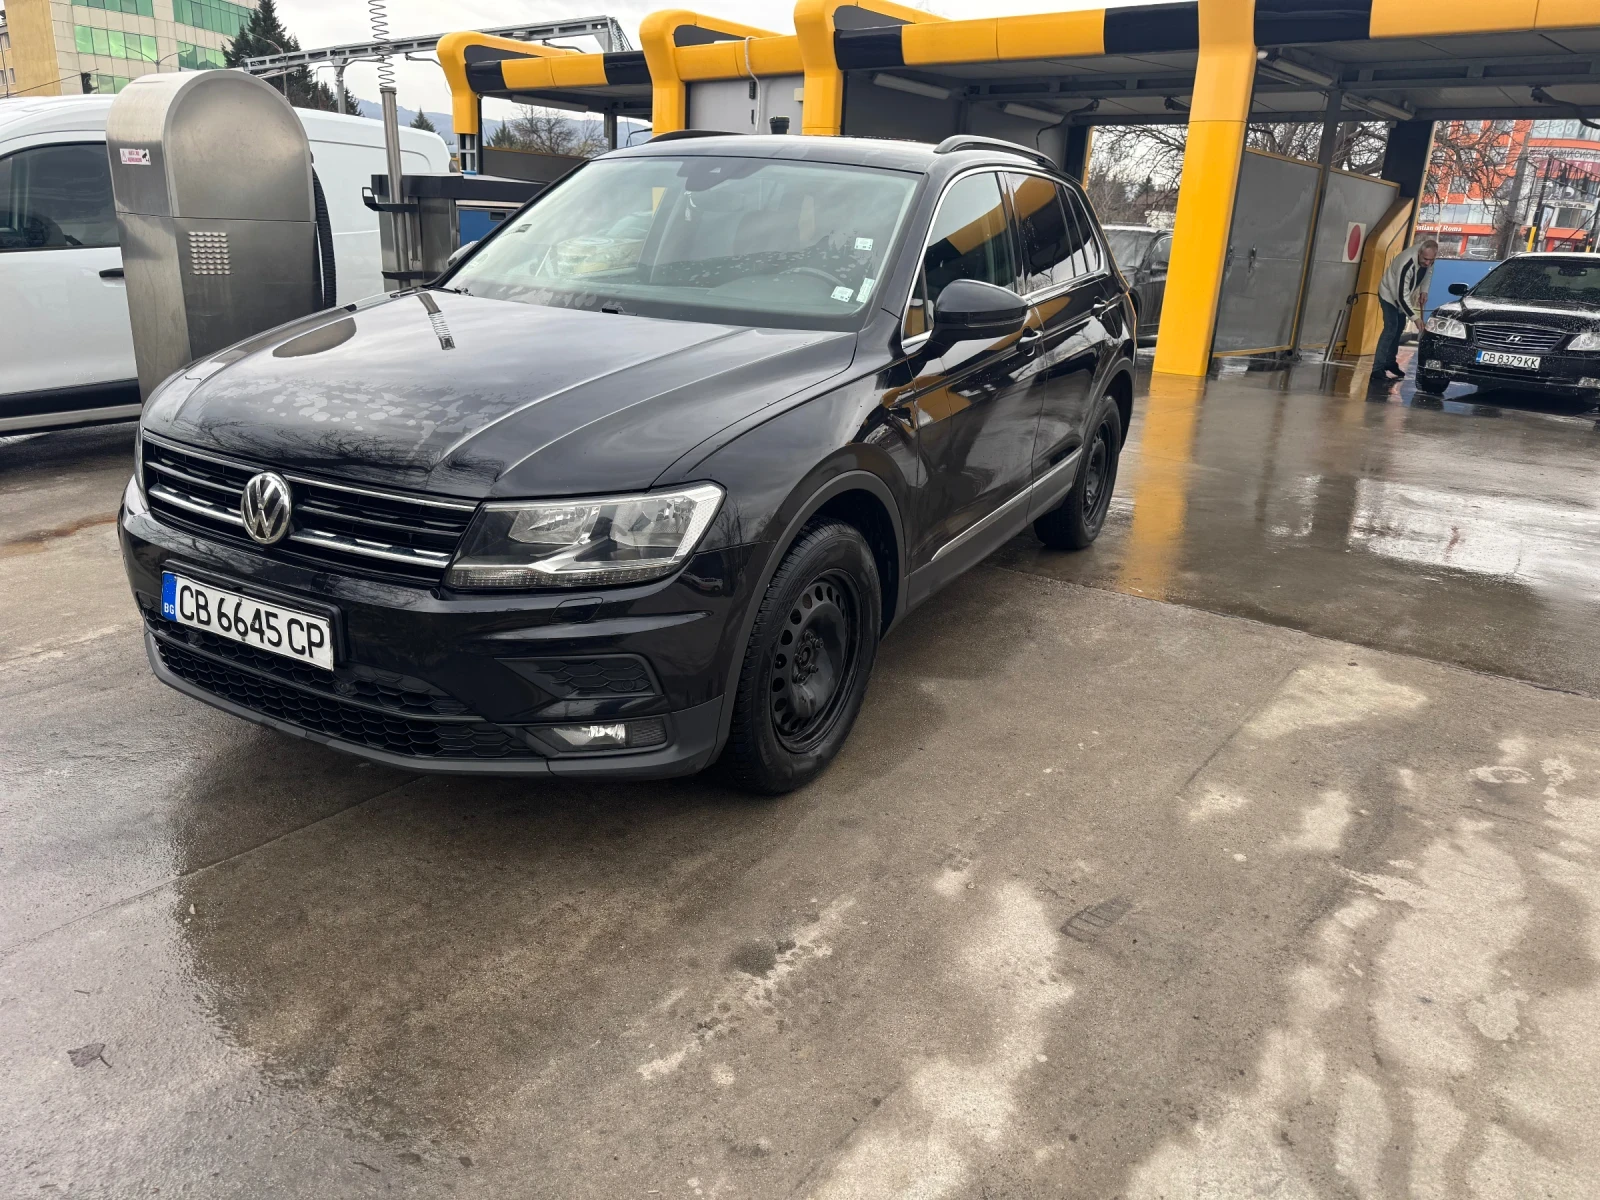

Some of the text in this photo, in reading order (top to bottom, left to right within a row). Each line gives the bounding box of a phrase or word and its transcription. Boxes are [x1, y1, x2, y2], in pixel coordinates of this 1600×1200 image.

[1482, 352, 1538, 367] CB 8379 KK
[164, 584, 325, 658] BG CB 6645 CP
